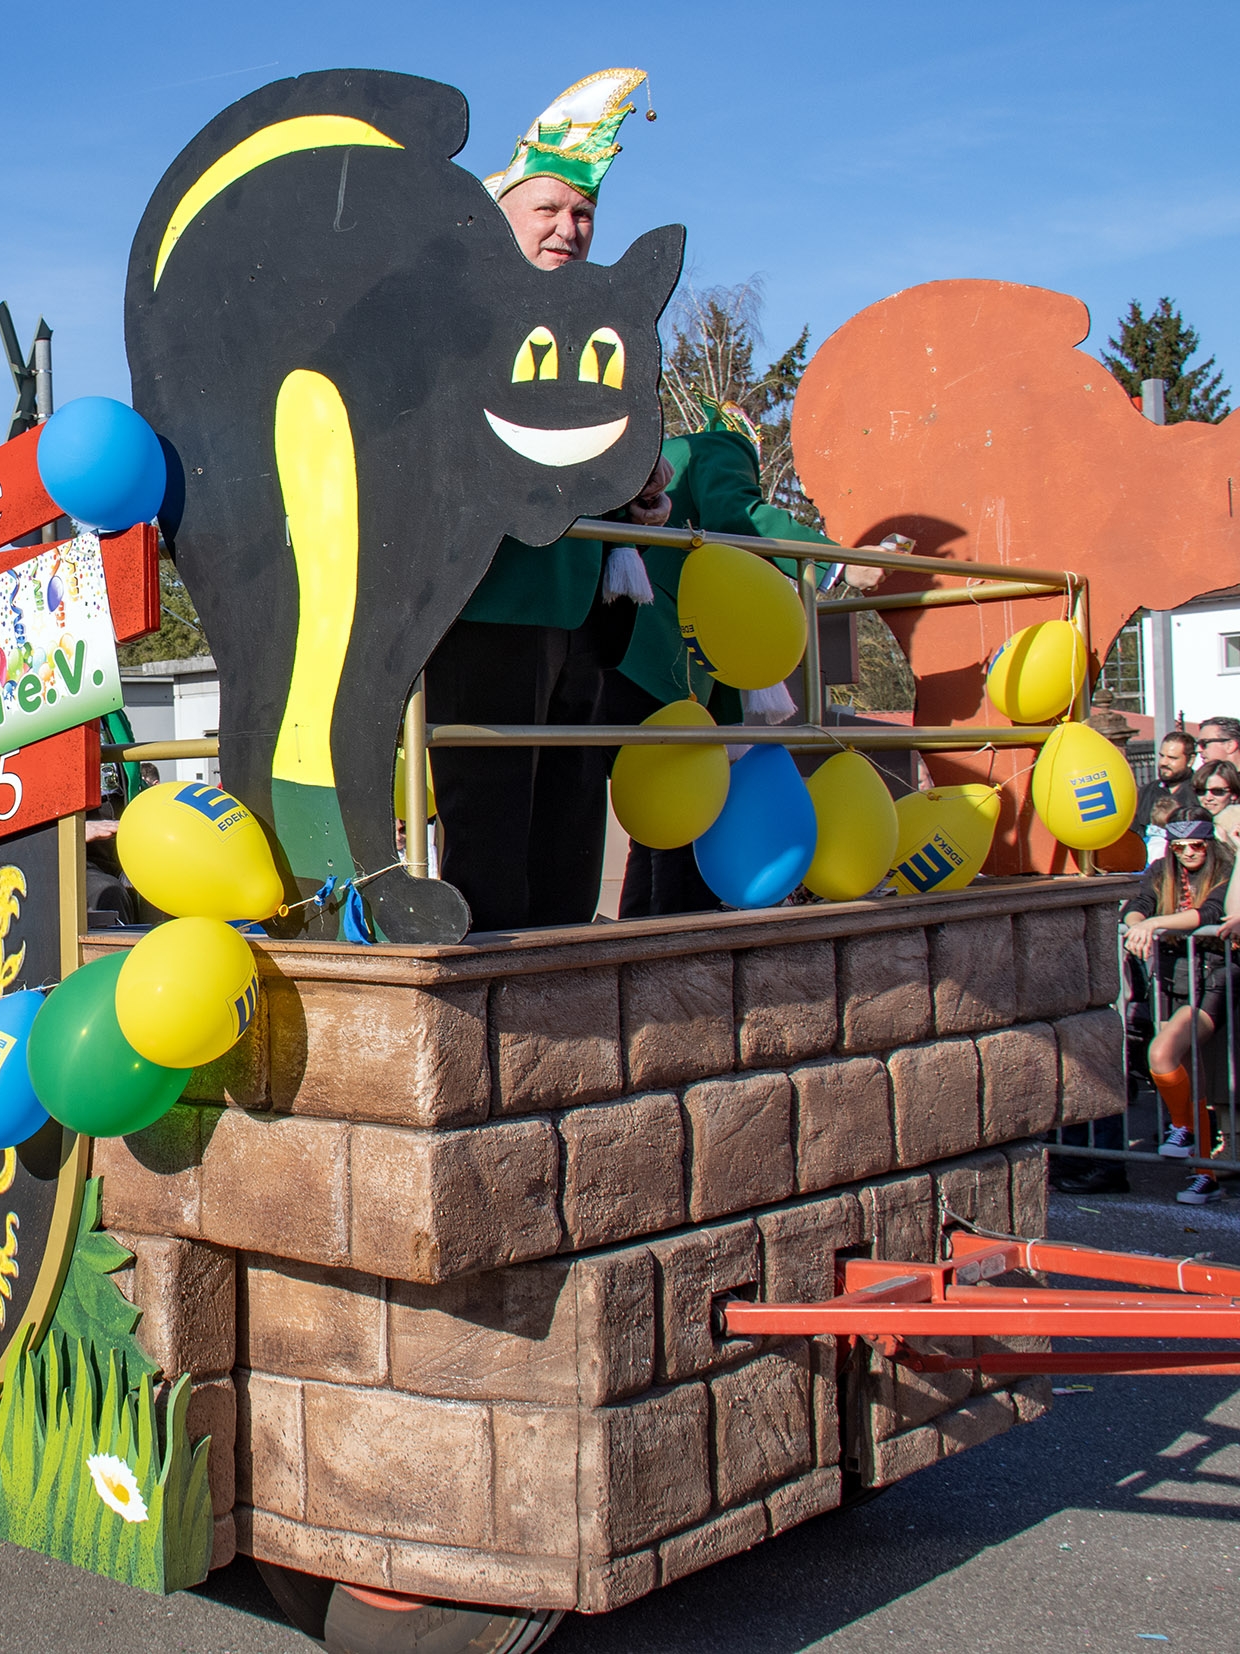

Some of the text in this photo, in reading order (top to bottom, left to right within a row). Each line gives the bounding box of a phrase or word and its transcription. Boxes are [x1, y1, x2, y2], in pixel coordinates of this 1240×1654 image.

[17, 639, 104, 713] e.V.
[1069, 770, 1108, 786] EDEKA
[217, 810, 250, 832] EDEKA
[933, 833, 964, 866] EDEKA
